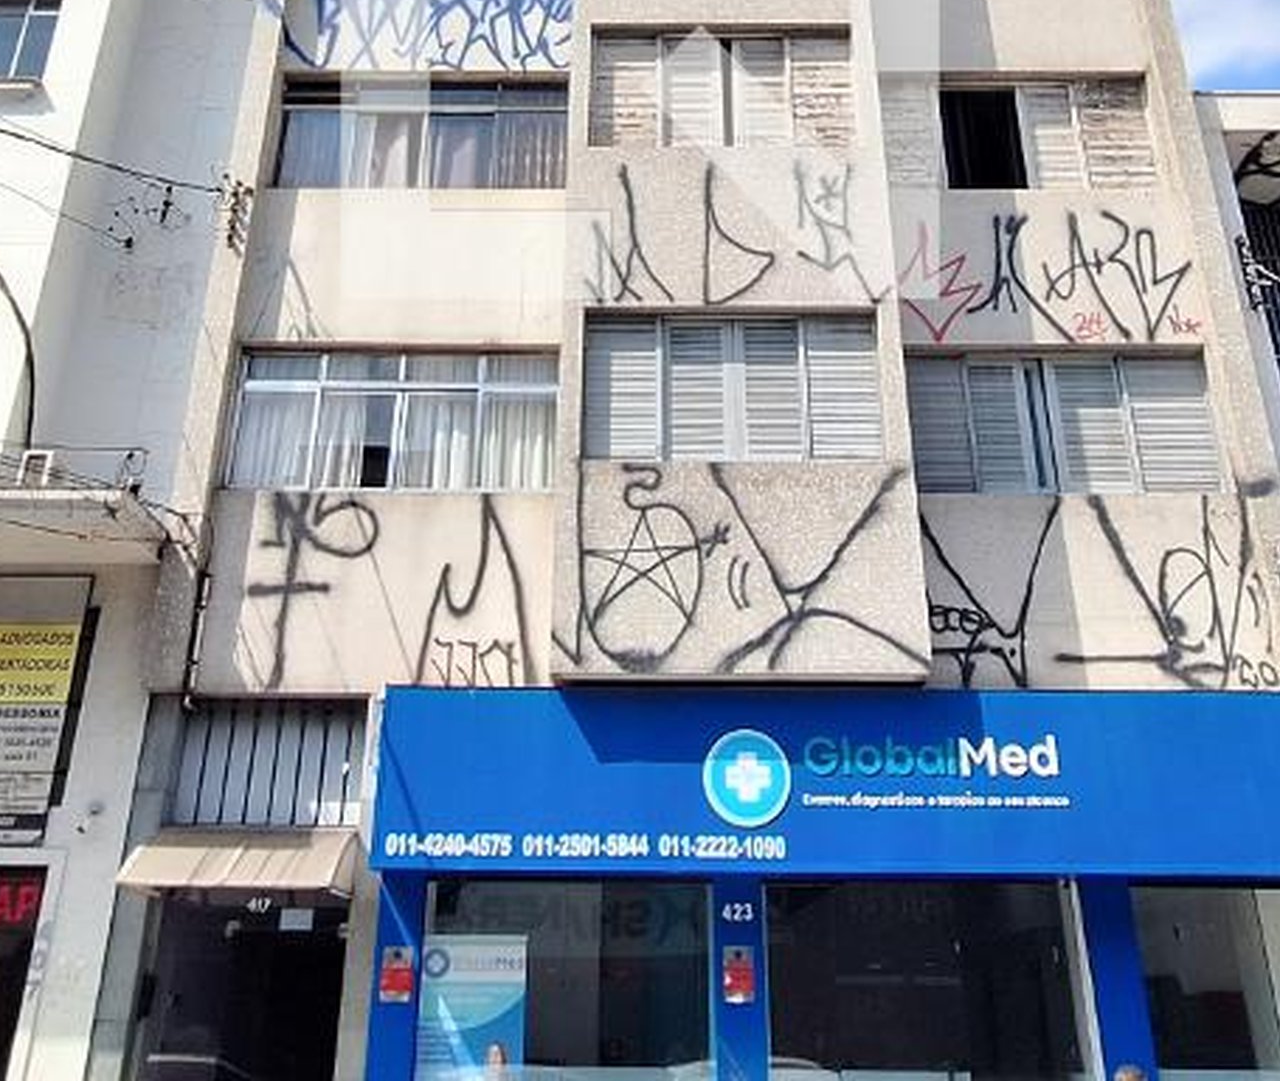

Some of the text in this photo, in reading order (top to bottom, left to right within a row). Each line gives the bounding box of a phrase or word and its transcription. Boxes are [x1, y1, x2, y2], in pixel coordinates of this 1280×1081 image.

[803, 734, 1060, 777] GlobalMed
[522, 832, 651, 858] 011-2501-5844
[658, 834, 787, 860] 011-2222-1090
[722, 903, 754, 921] 423
